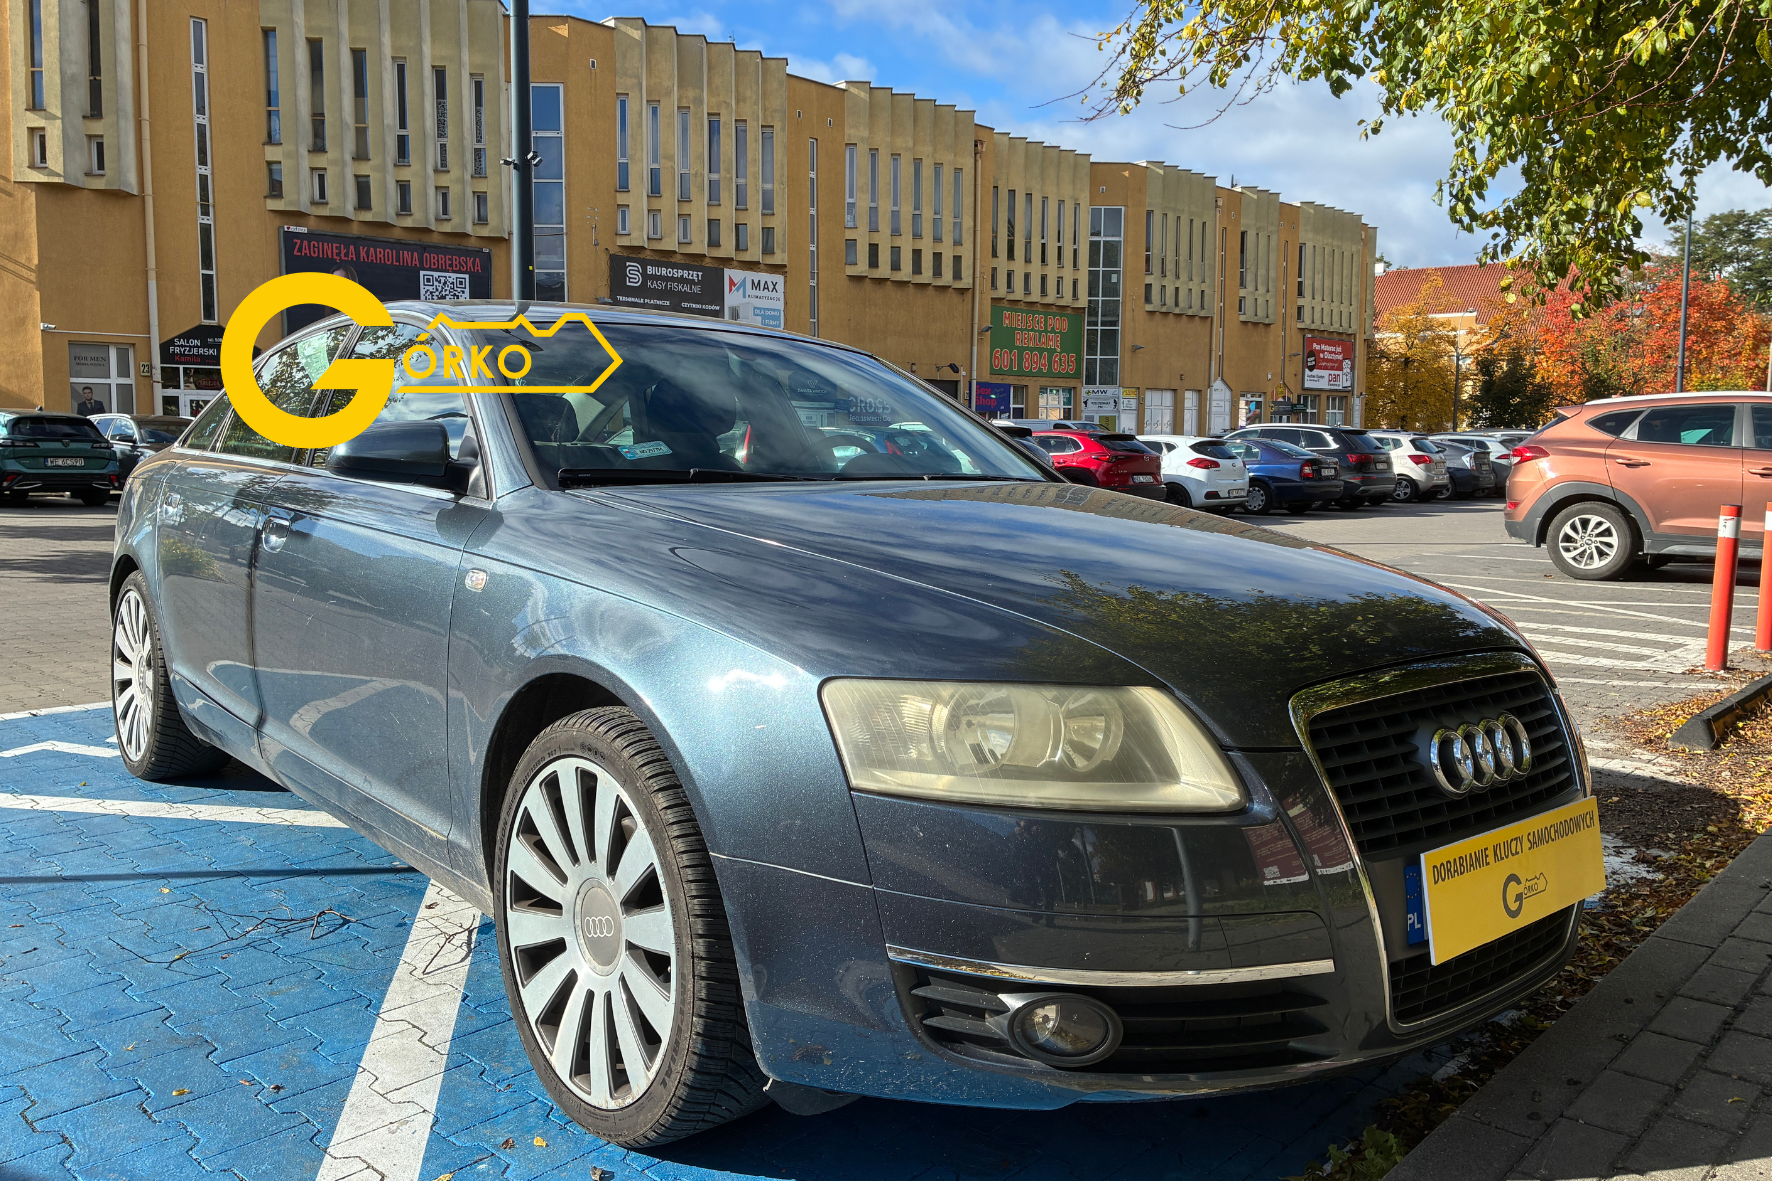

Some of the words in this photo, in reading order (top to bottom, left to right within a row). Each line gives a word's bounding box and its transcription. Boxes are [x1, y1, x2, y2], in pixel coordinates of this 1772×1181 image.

[293, 239, 356, 262] ZAGINĘŁA
[360, 246, 420, 267] KAROLINA
[423, 252, 482, 273] OBRĘBSKA
[646, 265, 703, 282] BIUROSPRZĘT
[647, 279, 666, 290] KASY
[667, 281, 702, 294] FISKALNE
[751, 278, 779, 293] MAX
[702, 303, 720, 312] KODÓW
[1003, 310, 1045, 330] MIEJSCE
[1047, 315, 1068, 333] POD
[174, 338, 201, 346] SALON
[1015, 330, 1061, 352] REKLAMĘ
[169, 346, 217, 356] FRYZJERSKI
[992, 348, 1018, 371] 601
[1022, 350, 1048, 372] 894
[1052, 353, 1076, 373] 635
[141, 363, 150, 374] 23
[1328, 373, 1340, 386] pan
[975, 385, 991, 395] Sex
[848, 396, 892, 414] CROSS
[975, 398, 997, 408] Shop
[1432, 846, 1490, 885] DORABIANIE
[1493, 835, 1525, 863] KLUCZY
[1527, 810, 1596, 851] SAMOCHODOWYCH
[1407, 912, 1422, 931] PL
